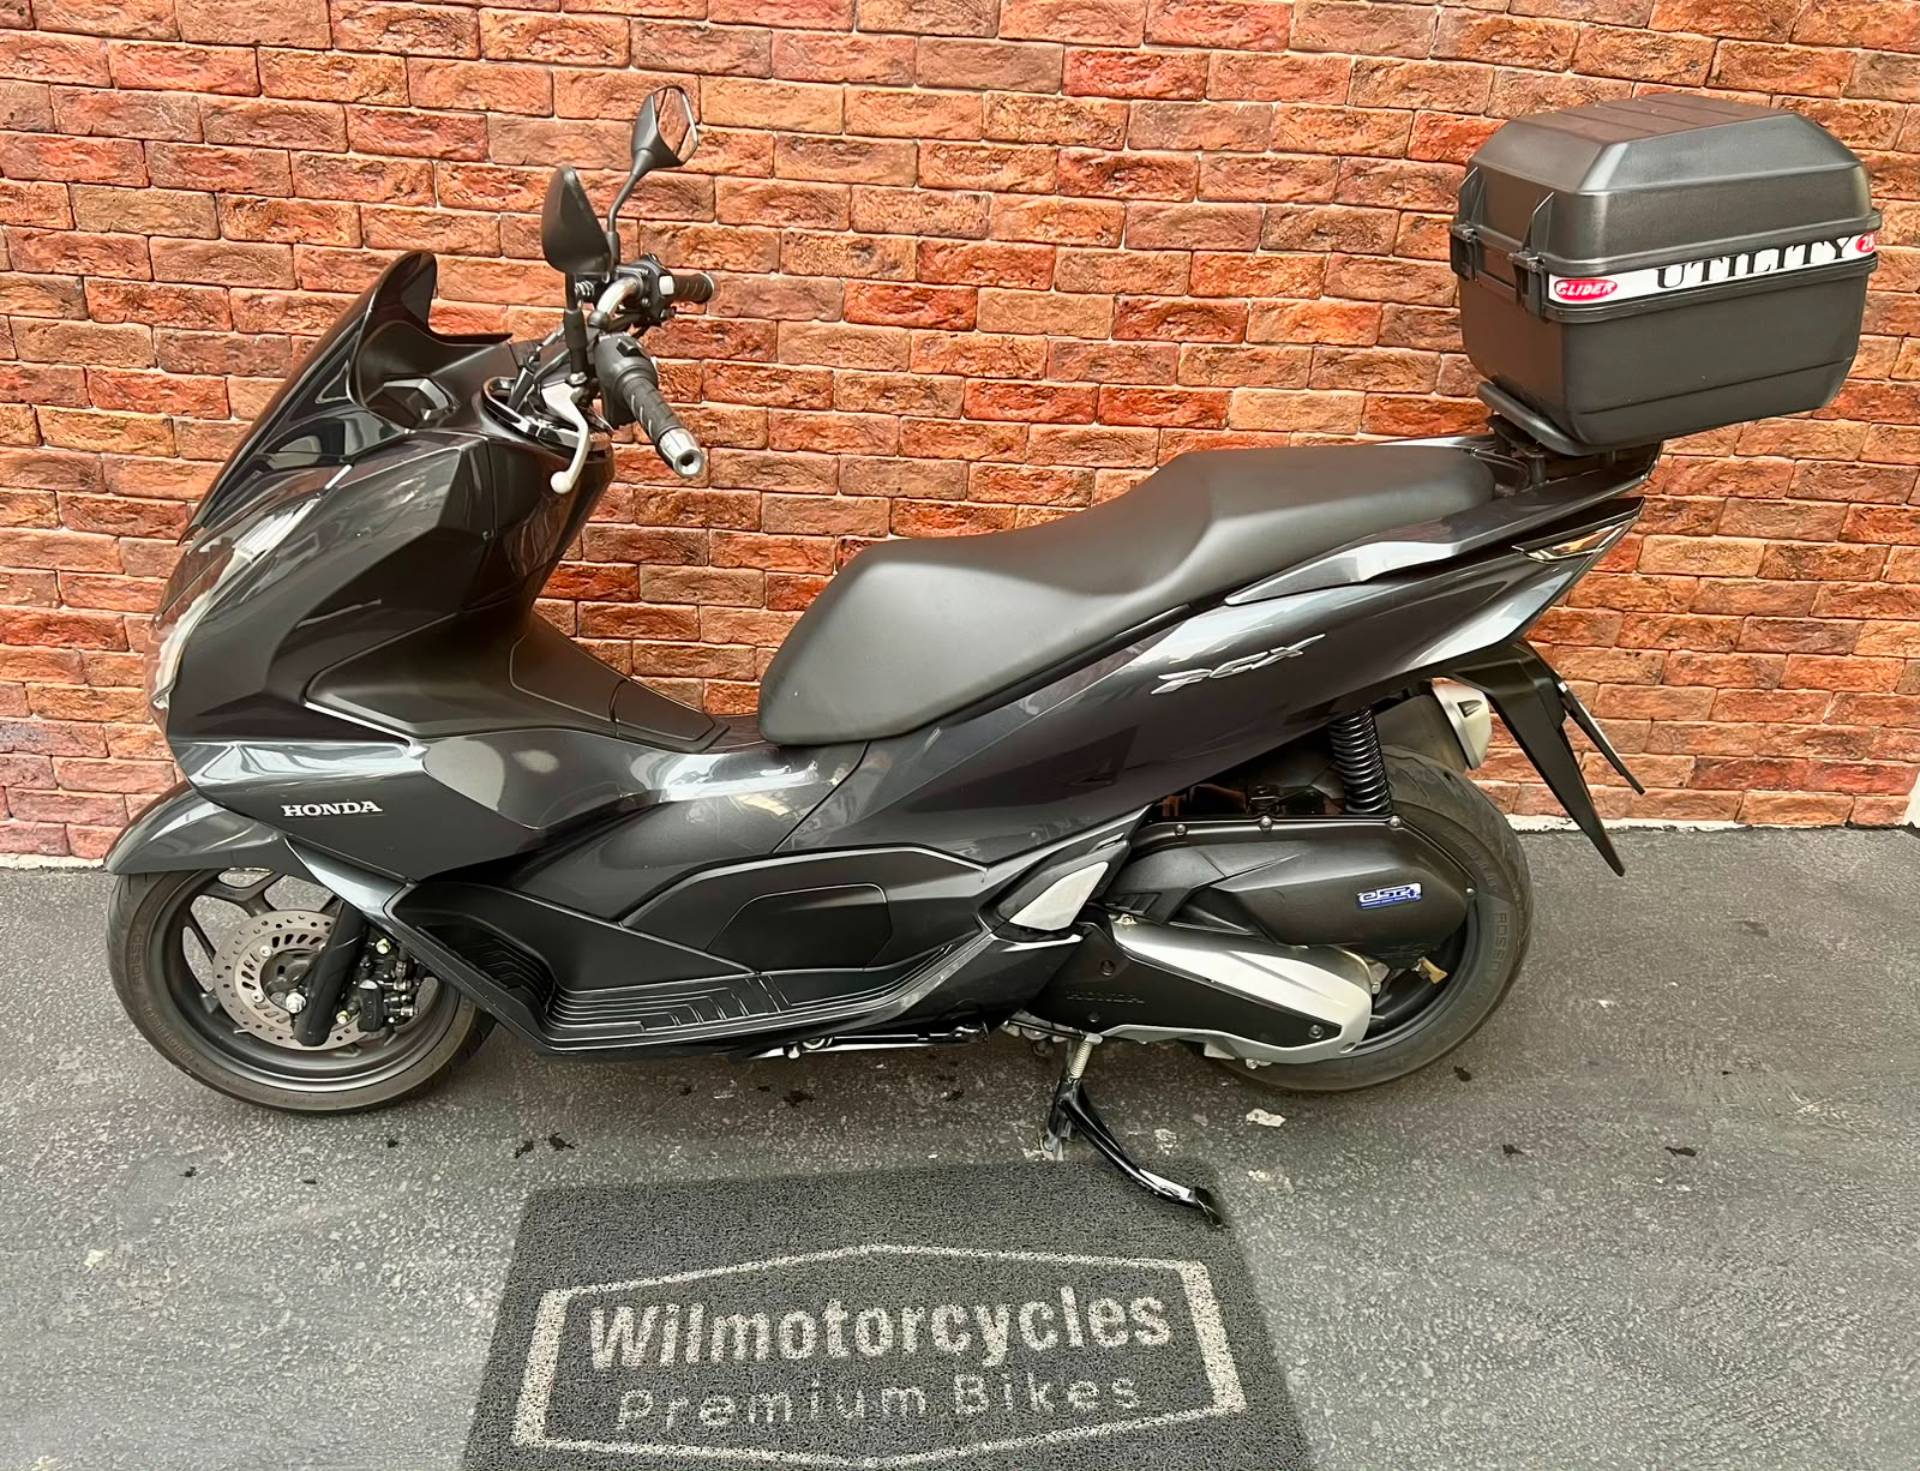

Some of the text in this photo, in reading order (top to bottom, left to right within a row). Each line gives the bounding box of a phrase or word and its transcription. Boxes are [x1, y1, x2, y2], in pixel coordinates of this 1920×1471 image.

[1555, 281, 1616, 297] GLIDER
[1656, 236, 1852, 289] UTILITY
[1151, 633, 1326, 694] PCX
[281, 800, 383, 817] HONDA
[590, 1285, 1171, 1369] Wilmotorcycles
[616, 1372, 1140, 1431] Premium Bikes
